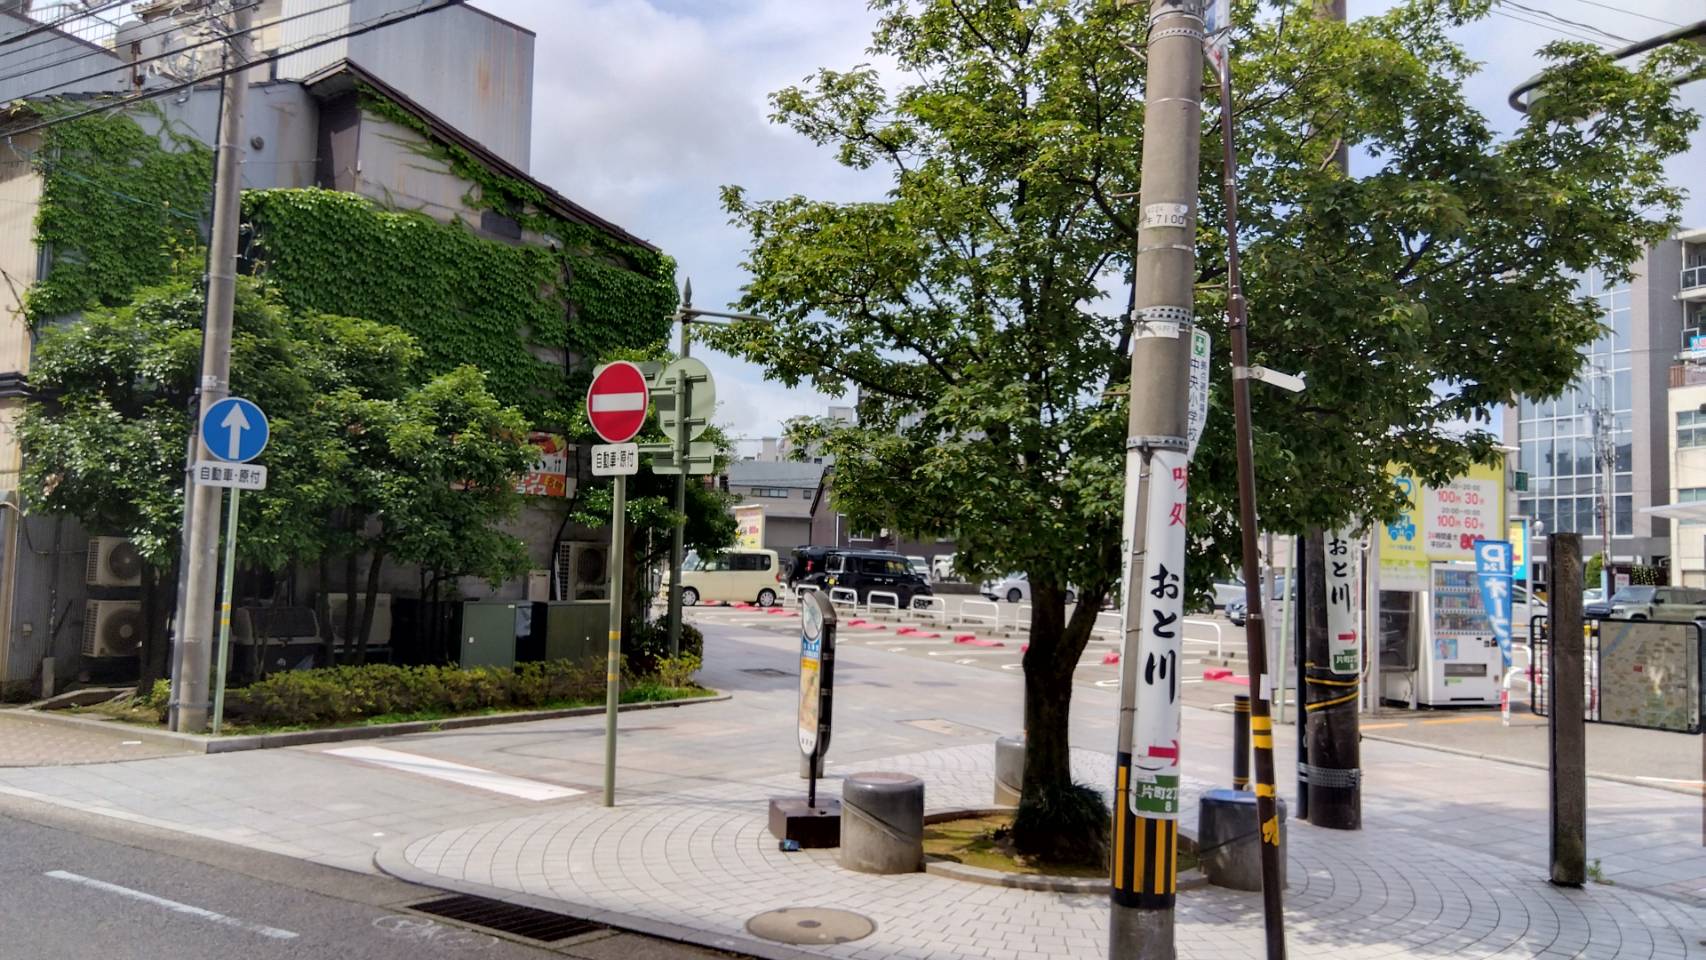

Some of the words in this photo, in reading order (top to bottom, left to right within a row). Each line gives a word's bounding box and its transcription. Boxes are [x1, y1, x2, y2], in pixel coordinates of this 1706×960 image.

[1187, 358, 1200, 441] 中央小学校
[200, 466, 261, 485] 自動車・原付
[1328, 538, 1350, 614] おと川
[1144, 562, 1180, 704] おと川
[1164, 800, 1173, 813] 8
